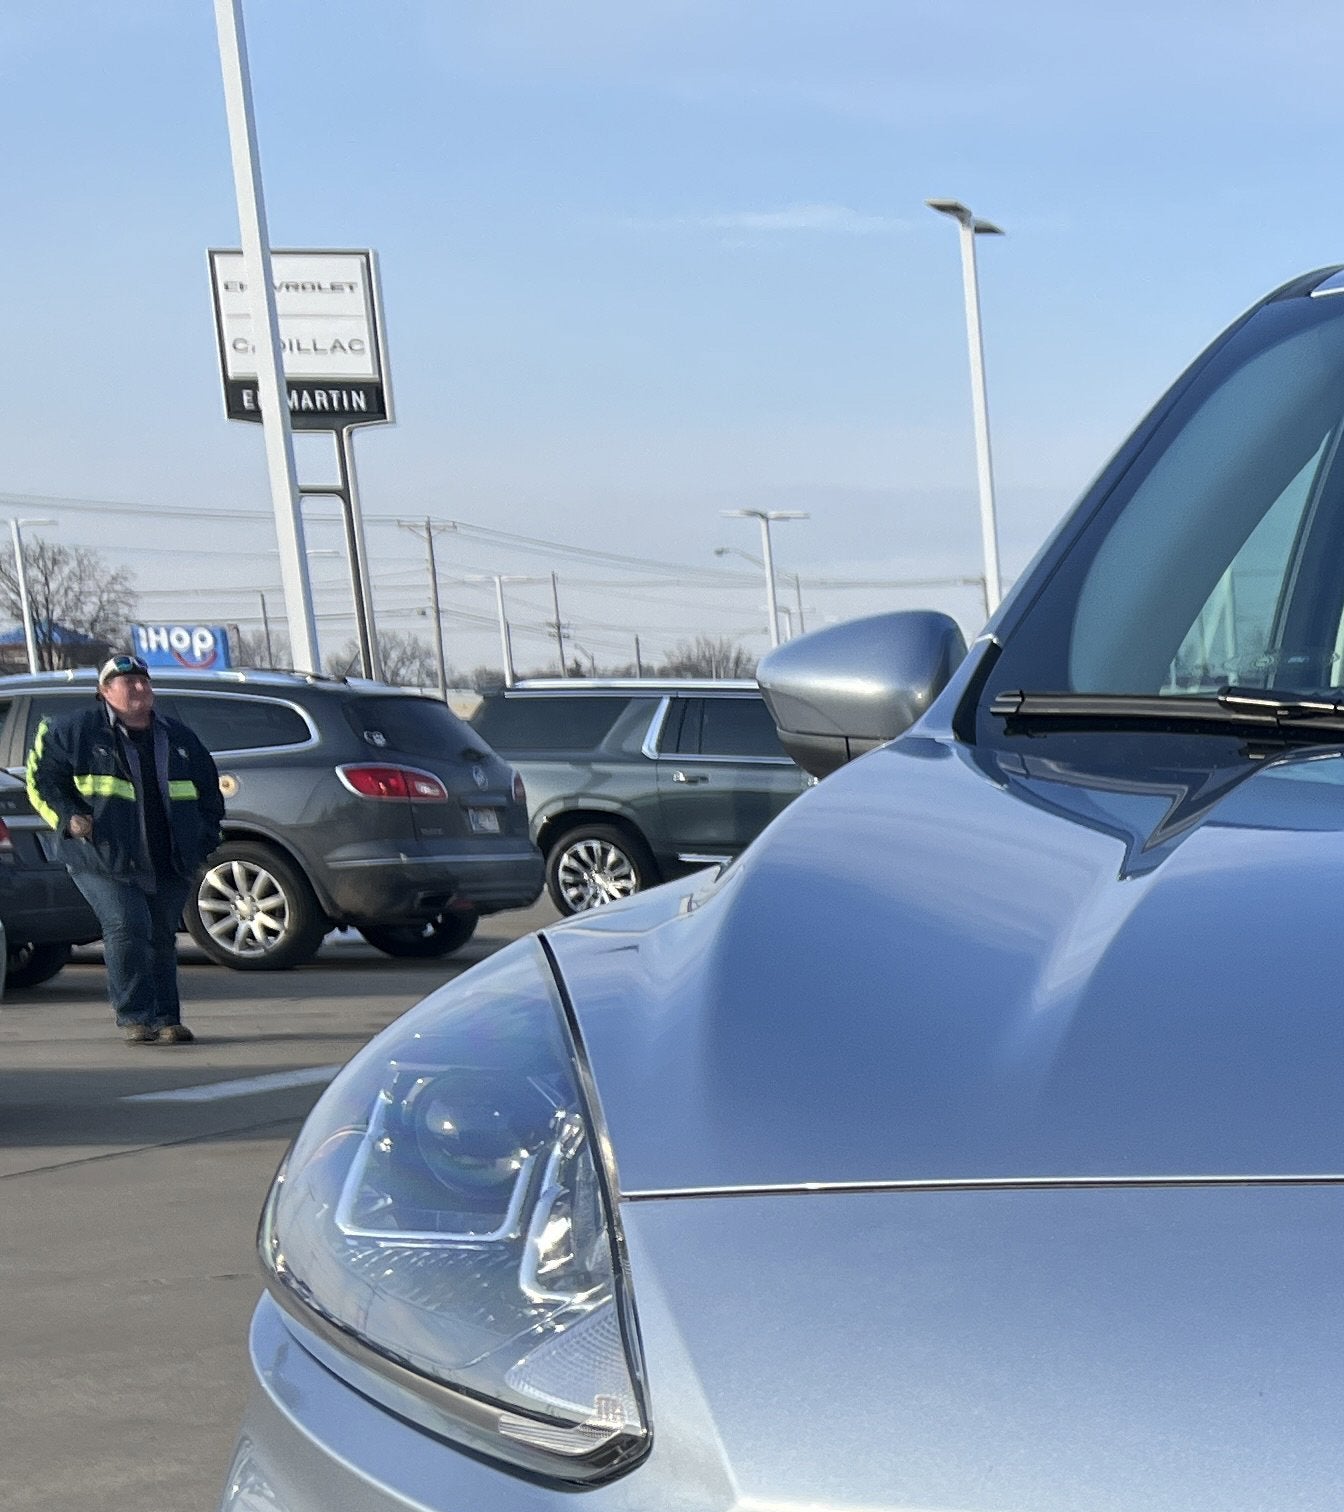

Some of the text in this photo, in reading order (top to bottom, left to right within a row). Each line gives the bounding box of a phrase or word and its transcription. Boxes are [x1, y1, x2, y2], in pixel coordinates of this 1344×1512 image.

[224, 280, 359, 294] CHVROLET
[232, 337, 366, 355] CILLAC
[286, 388, 367, 412] MARTIN
[138, 626, 214, 660] IHOP
